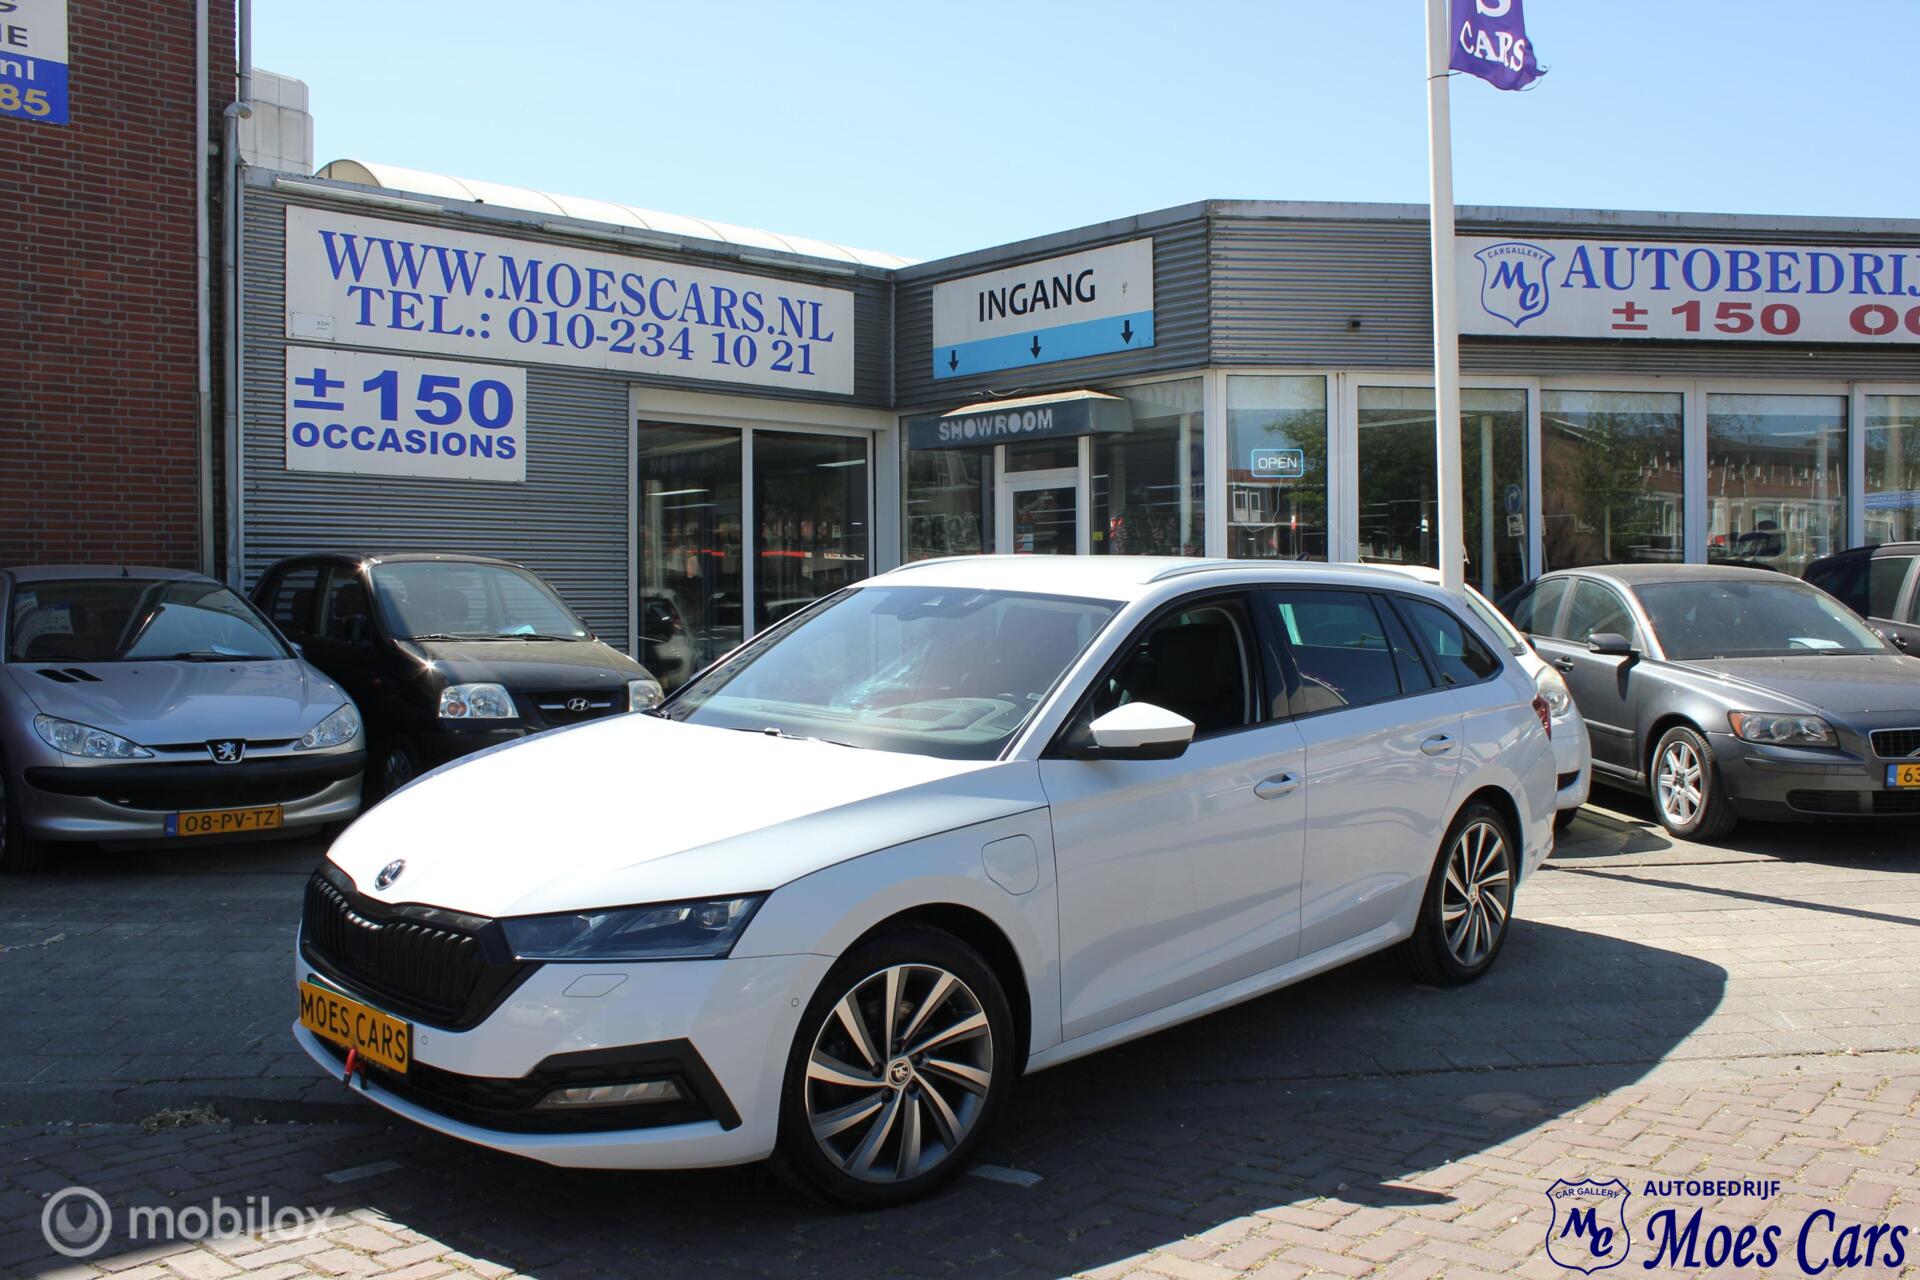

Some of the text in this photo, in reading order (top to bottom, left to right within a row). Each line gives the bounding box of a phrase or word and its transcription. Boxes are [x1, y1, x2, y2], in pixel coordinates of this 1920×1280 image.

[1460, 20, 1525, 72] CARS
[318, 229, 834, 343] WWW.MOESCARS.NL
[979, 268, 1096, 323] INGANG
[346, 284, 814, 376] TEL.: 010-234 10 21
[291, 420, 517, 460] OCCASIONS
[938, 407, 1054, 441] SHOWROOM
[1257, 456, 1298, 470] OPEN
[184, 810, 275, 832] 08-PV-TZ
[300, 988, 350, 1038] MOES
[355, 1012, 406, 1064] CARS
